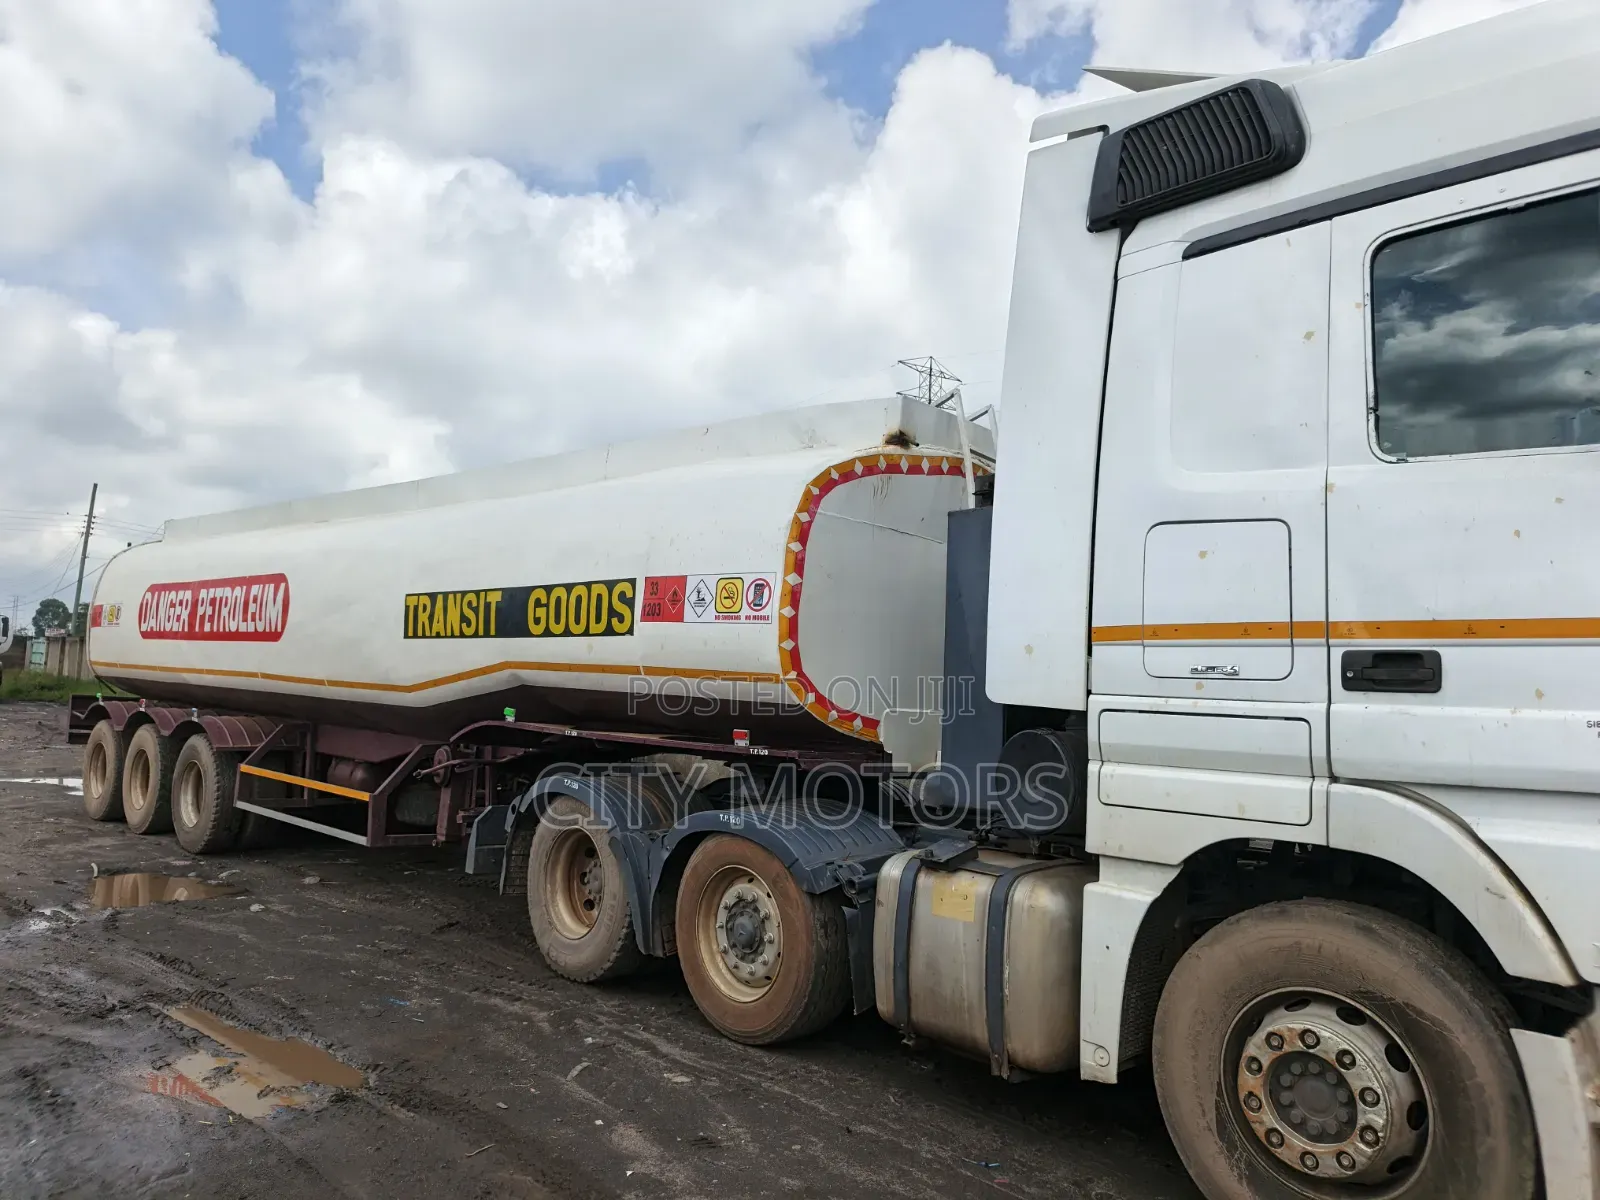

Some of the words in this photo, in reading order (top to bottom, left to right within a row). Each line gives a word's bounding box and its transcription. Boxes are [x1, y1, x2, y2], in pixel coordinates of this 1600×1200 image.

[650, 582, 659, 597] 33
[141, 590, 192, 632] DANGER
[195, 583, 286, 632] PETROLEUM
[405, 590, 502, 637] TRANSIT
[528, 581, 633, 636] GOODS
[642, 602, 661, 617] 1203
